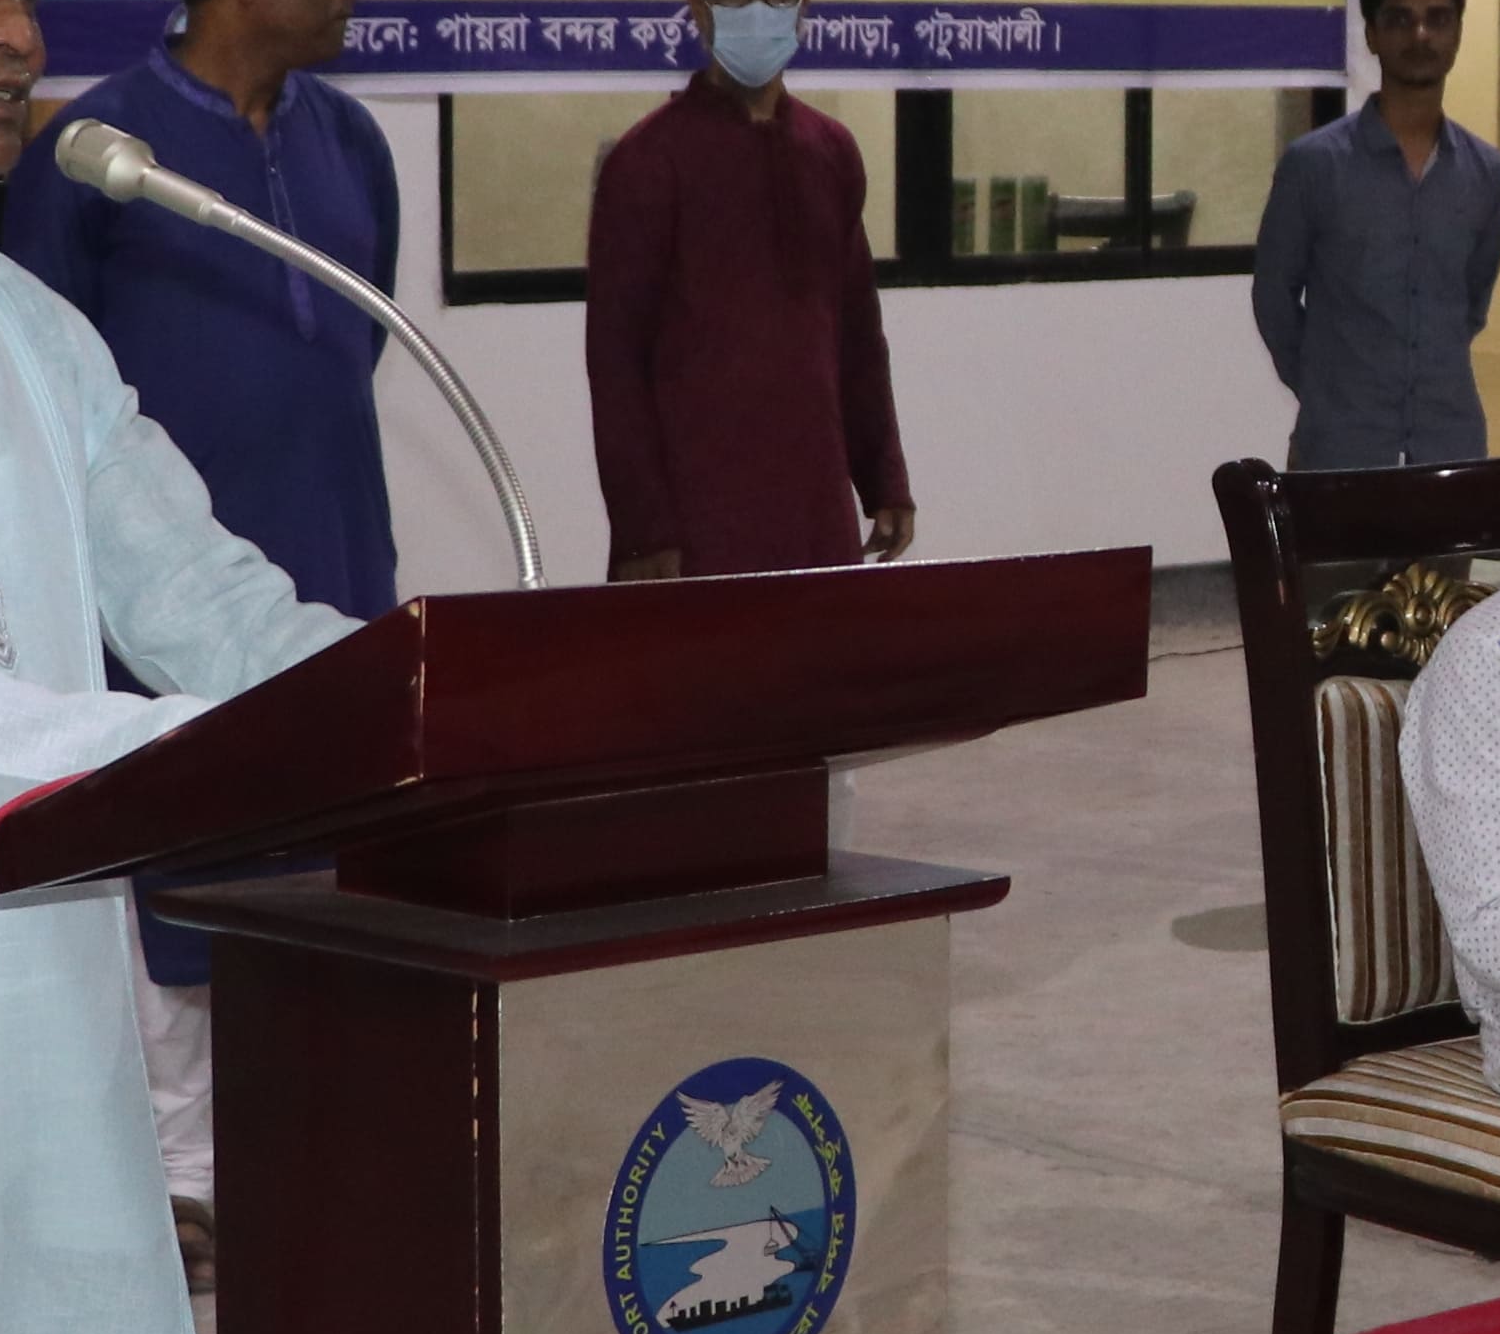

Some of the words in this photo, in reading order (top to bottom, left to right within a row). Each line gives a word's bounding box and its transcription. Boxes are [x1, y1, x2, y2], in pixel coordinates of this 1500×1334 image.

[436, 12, 527, 53] পায়রা
[540, 15, 619, 53] বন্দর
[615, 1122, 667, 1280] AUTHORITY
